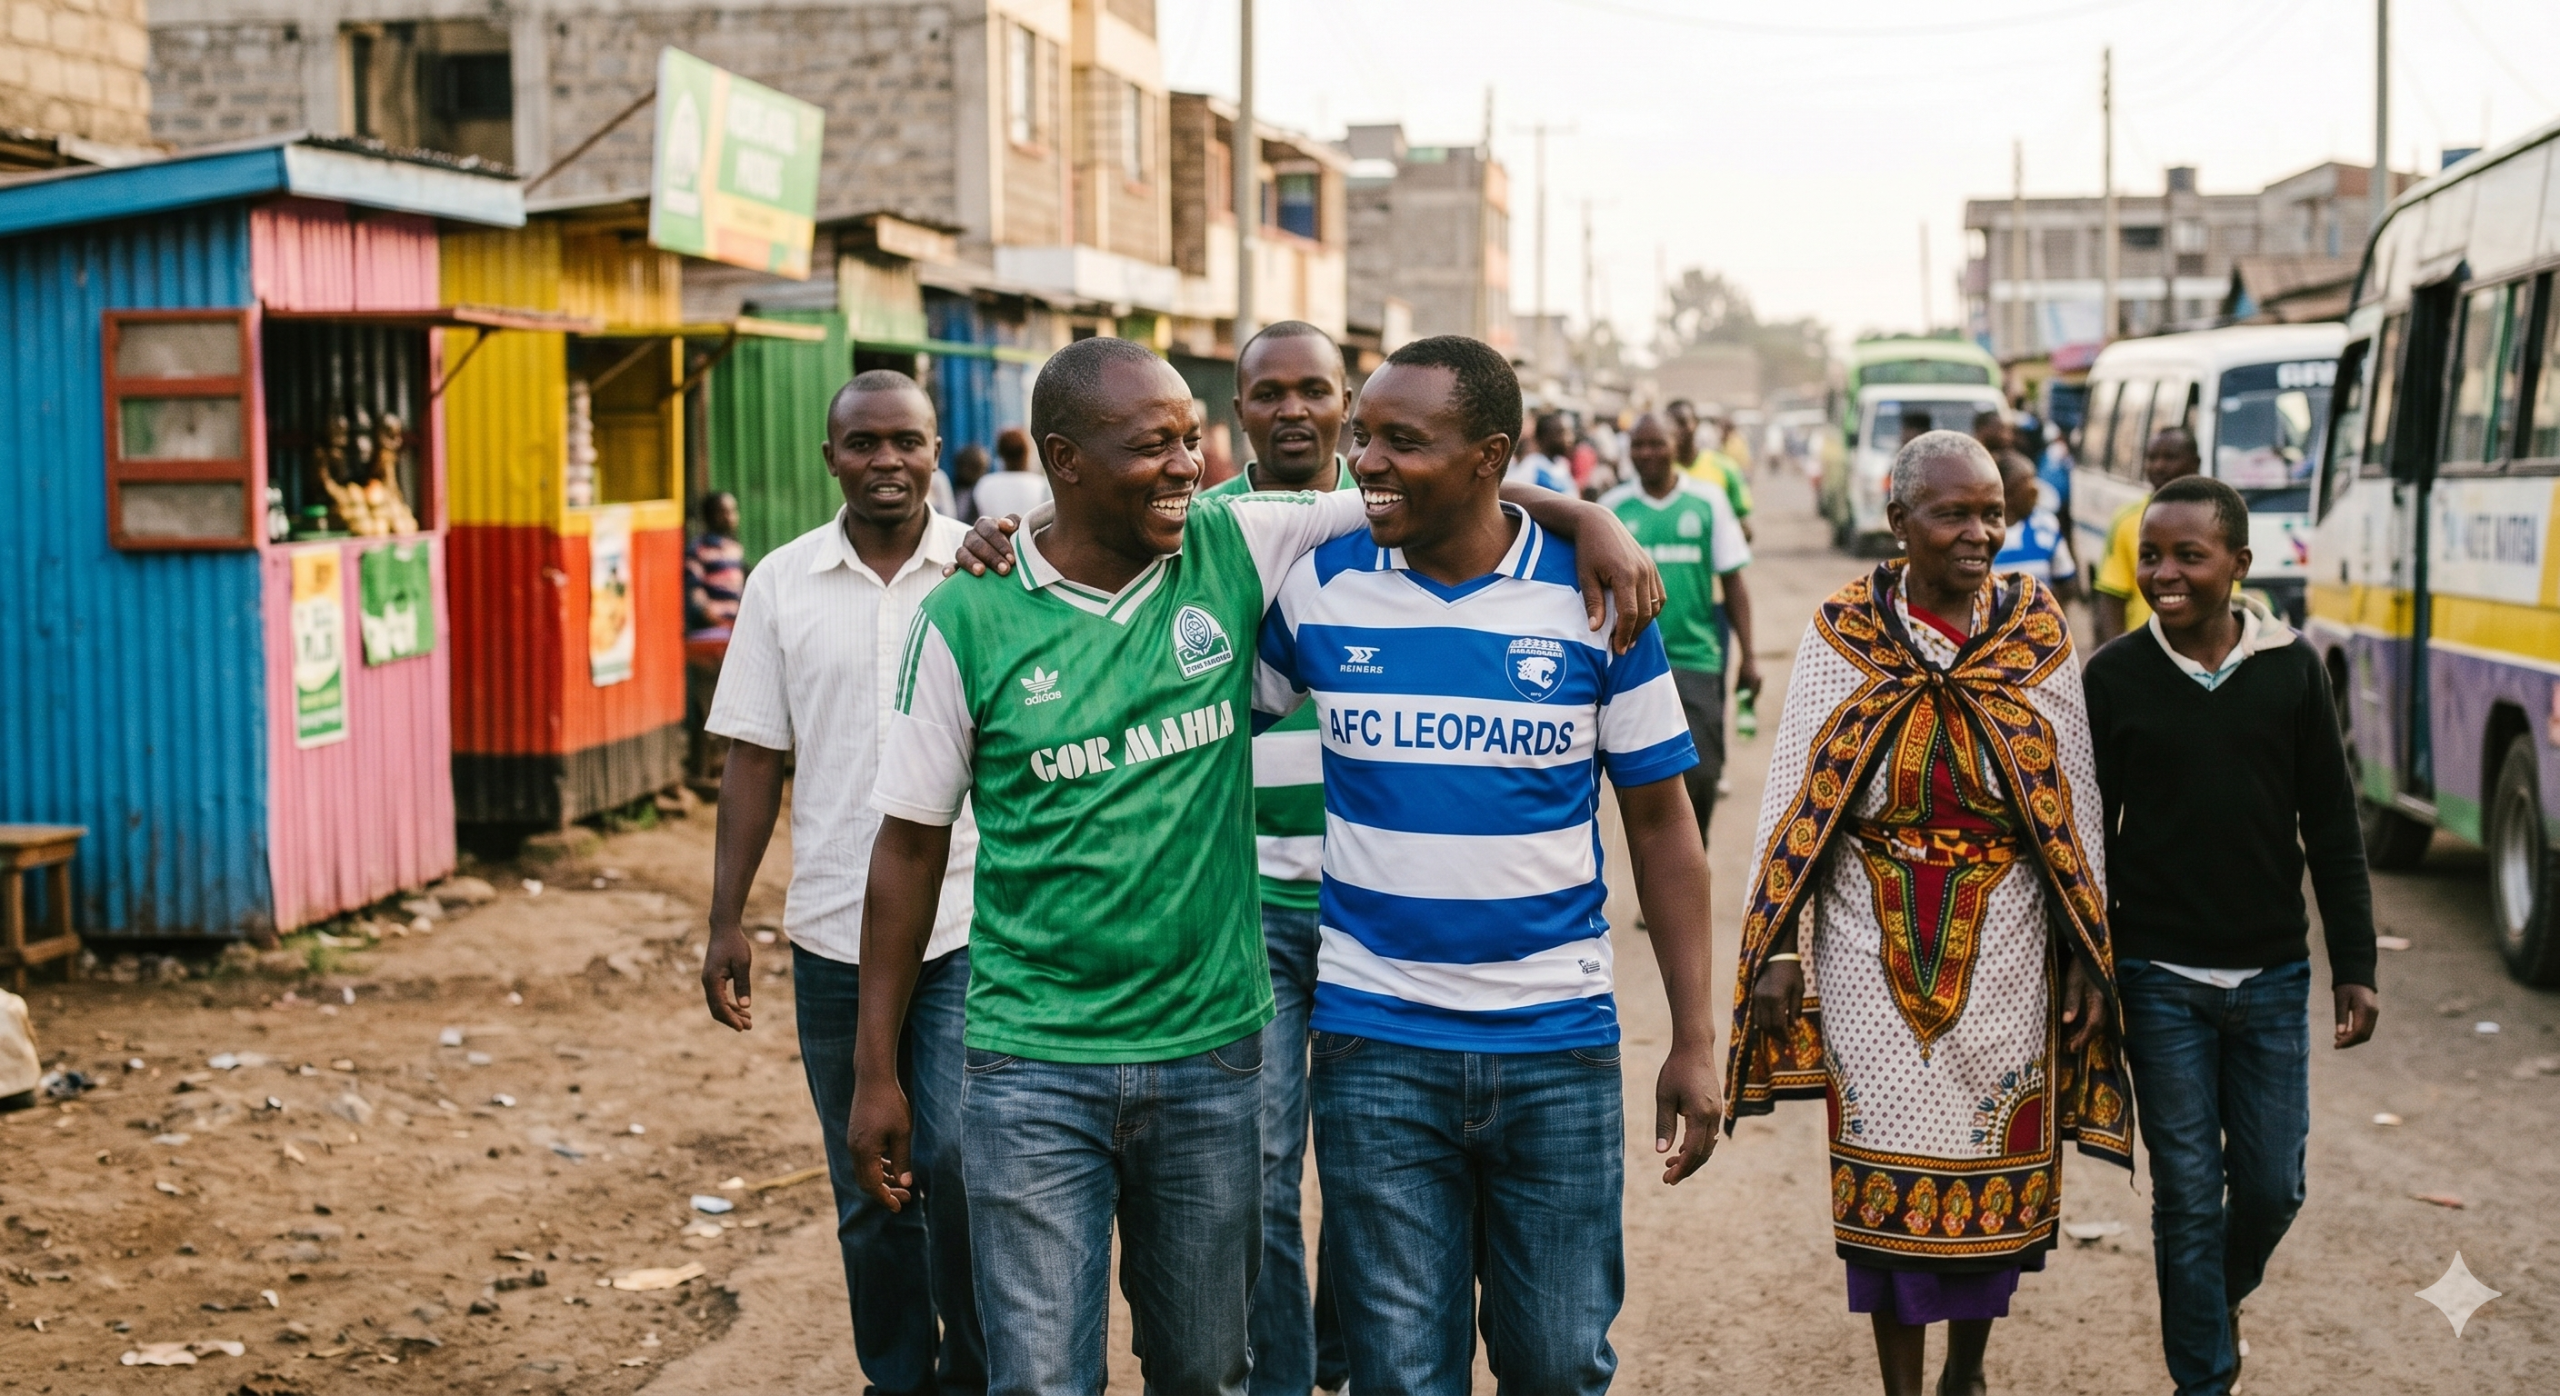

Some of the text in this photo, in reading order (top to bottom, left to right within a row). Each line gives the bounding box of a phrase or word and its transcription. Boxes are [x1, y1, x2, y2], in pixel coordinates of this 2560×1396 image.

[1340, 664, 1384, 674] REINERS
[1030, 699, 1235, 783] GOR MAHIA
[1330, 708, 1575, 757] AFC LEOPARDS
